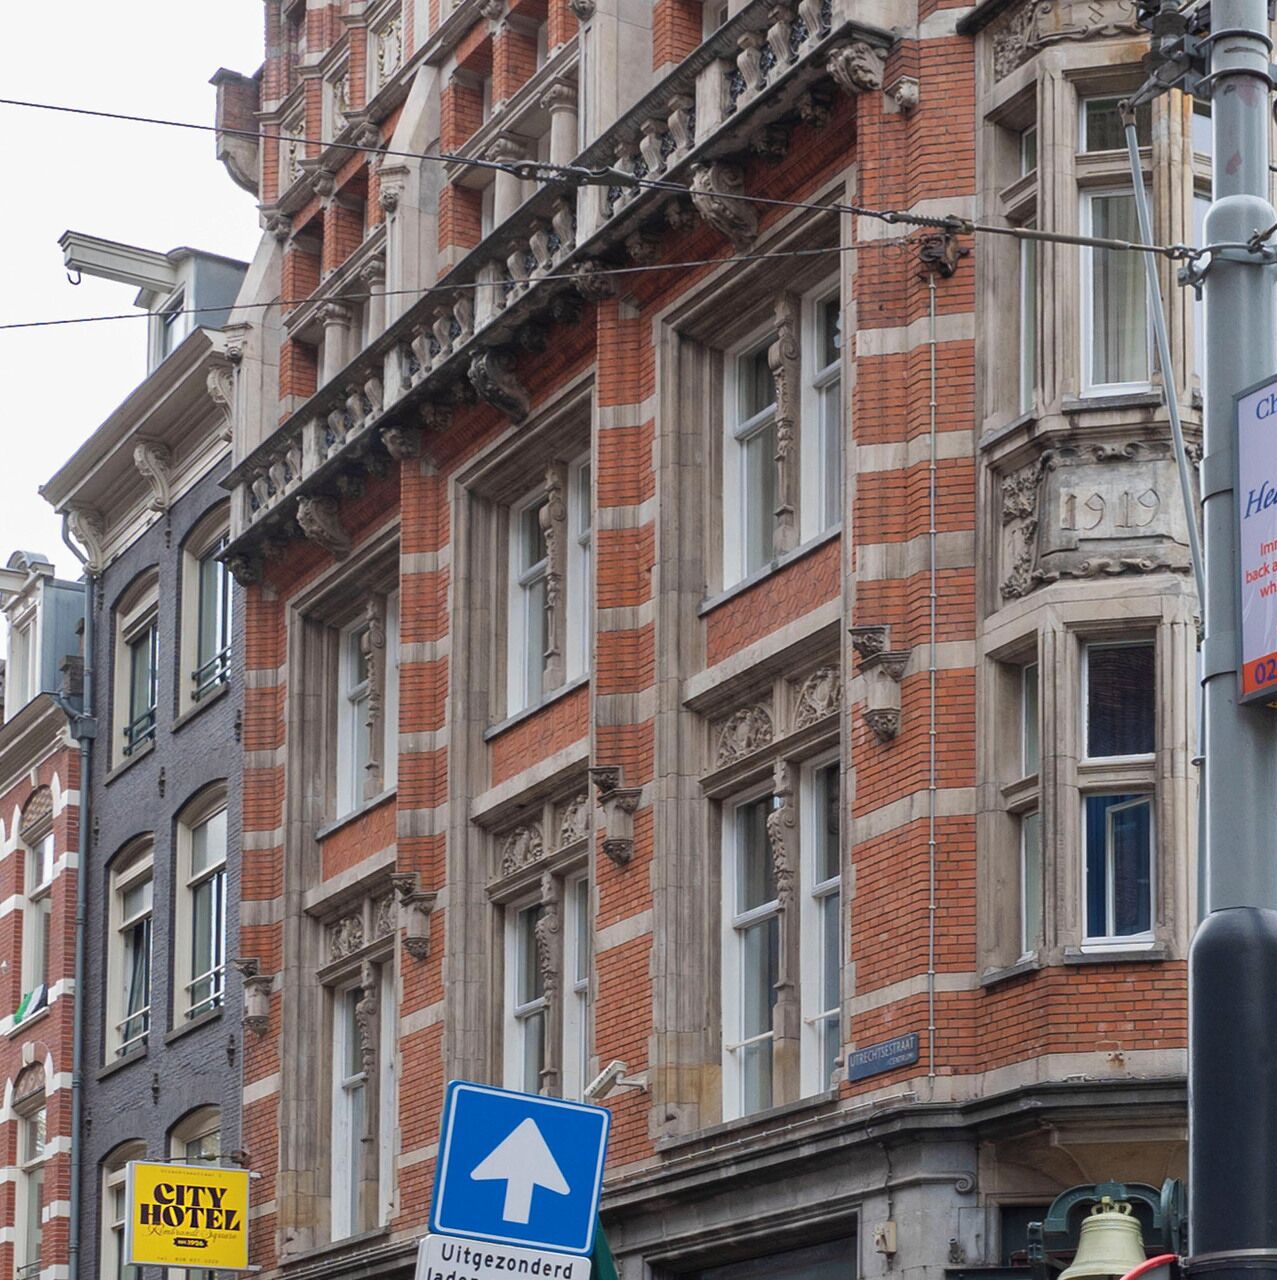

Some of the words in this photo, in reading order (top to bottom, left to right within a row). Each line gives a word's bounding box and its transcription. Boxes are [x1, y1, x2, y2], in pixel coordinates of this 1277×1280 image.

[1061, 488, 1161, 531] 1919
[1245, 563, 1270, 584] back
[851, 1037, 914, 1067] UTRECHTSESTRAAT
[153, 1183, 227, 1208] CITY
[140, 1203, 240, 1231] HOTEL
[441, 1243, 573, 1280] Uitgezonderd
